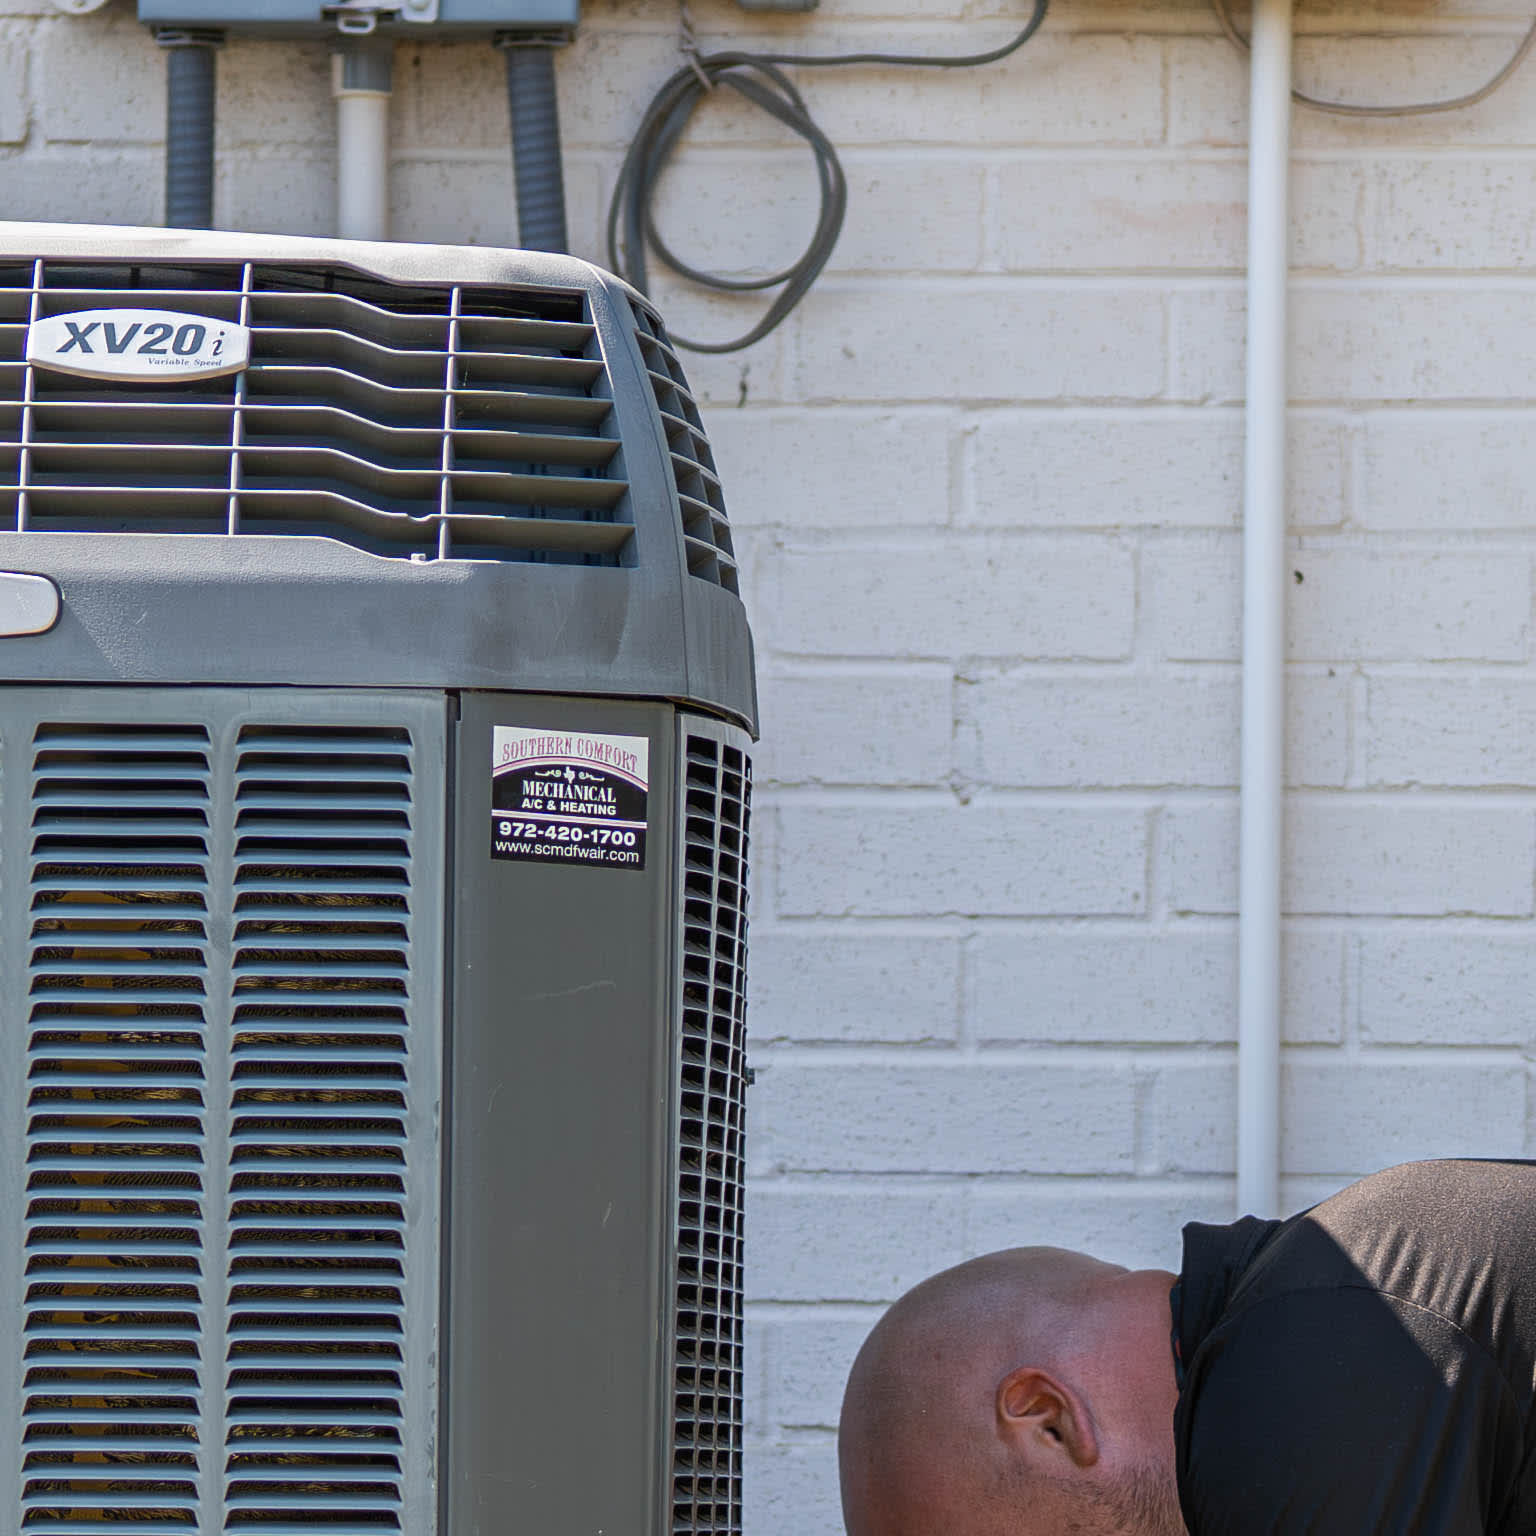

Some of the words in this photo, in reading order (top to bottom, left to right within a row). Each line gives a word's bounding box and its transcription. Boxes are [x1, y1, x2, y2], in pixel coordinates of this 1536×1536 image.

[148, 357, 190, 366] Variable
[194, 358, 222, 367] Speed
[502, 736, 573, 762] SOUTHERN
[577, 738, 638, 773] COMFORT
[522, 780, 617, 803] MECHANICAL
[521, 798, 543, 810] A/C
[547, 800, 557, 811] &
[560, 801, 617, 816] HEATING
[499, 821, 636, 846] 972-420-1700
[495, 840, 639, 863] www.scmdfwair.com
